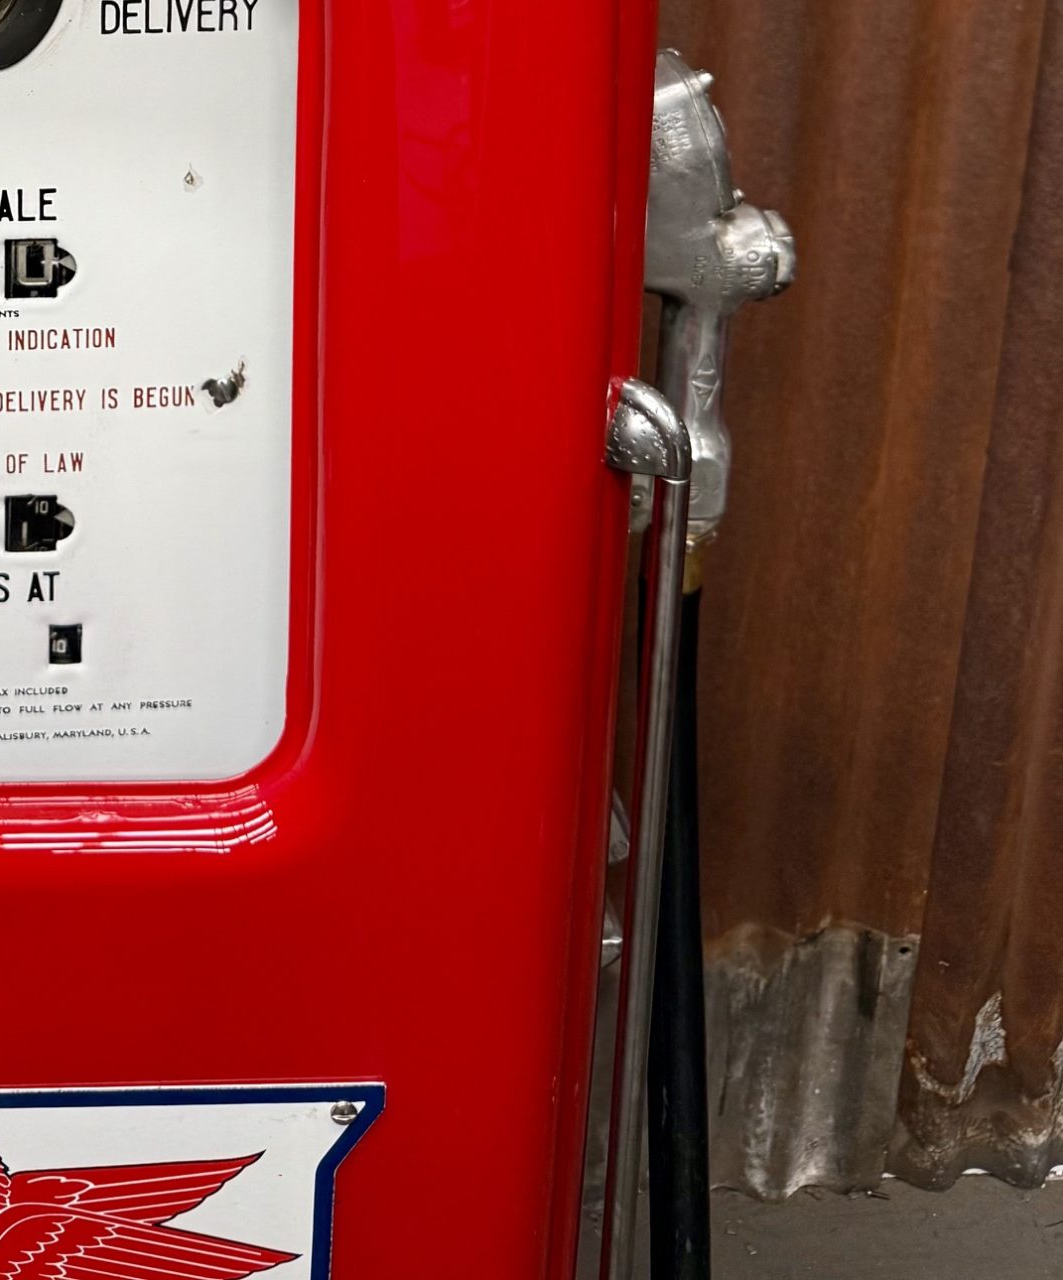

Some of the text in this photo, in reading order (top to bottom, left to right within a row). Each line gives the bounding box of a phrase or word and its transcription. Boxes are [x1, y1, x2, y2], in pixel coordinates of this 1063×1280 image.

[8, 327, 116, 351] INDICATION
[101, 388, 118, 410] IS
[133, 385, 195, 409] BEGUN
[6, 453, 29, 474] OF
[43, 452, 84, 473] LAW
[26, 571, 61, 603] AT
[14, 686, 68, 696] INCLUDED
[19, 705, 45, 714] FULL
[52, 704, 83, 713] FLOW
[89, 702, 103, 711] AT
[110, 702, 132, 710] ANY
[139, 699, 192, 710] PRESSURE
